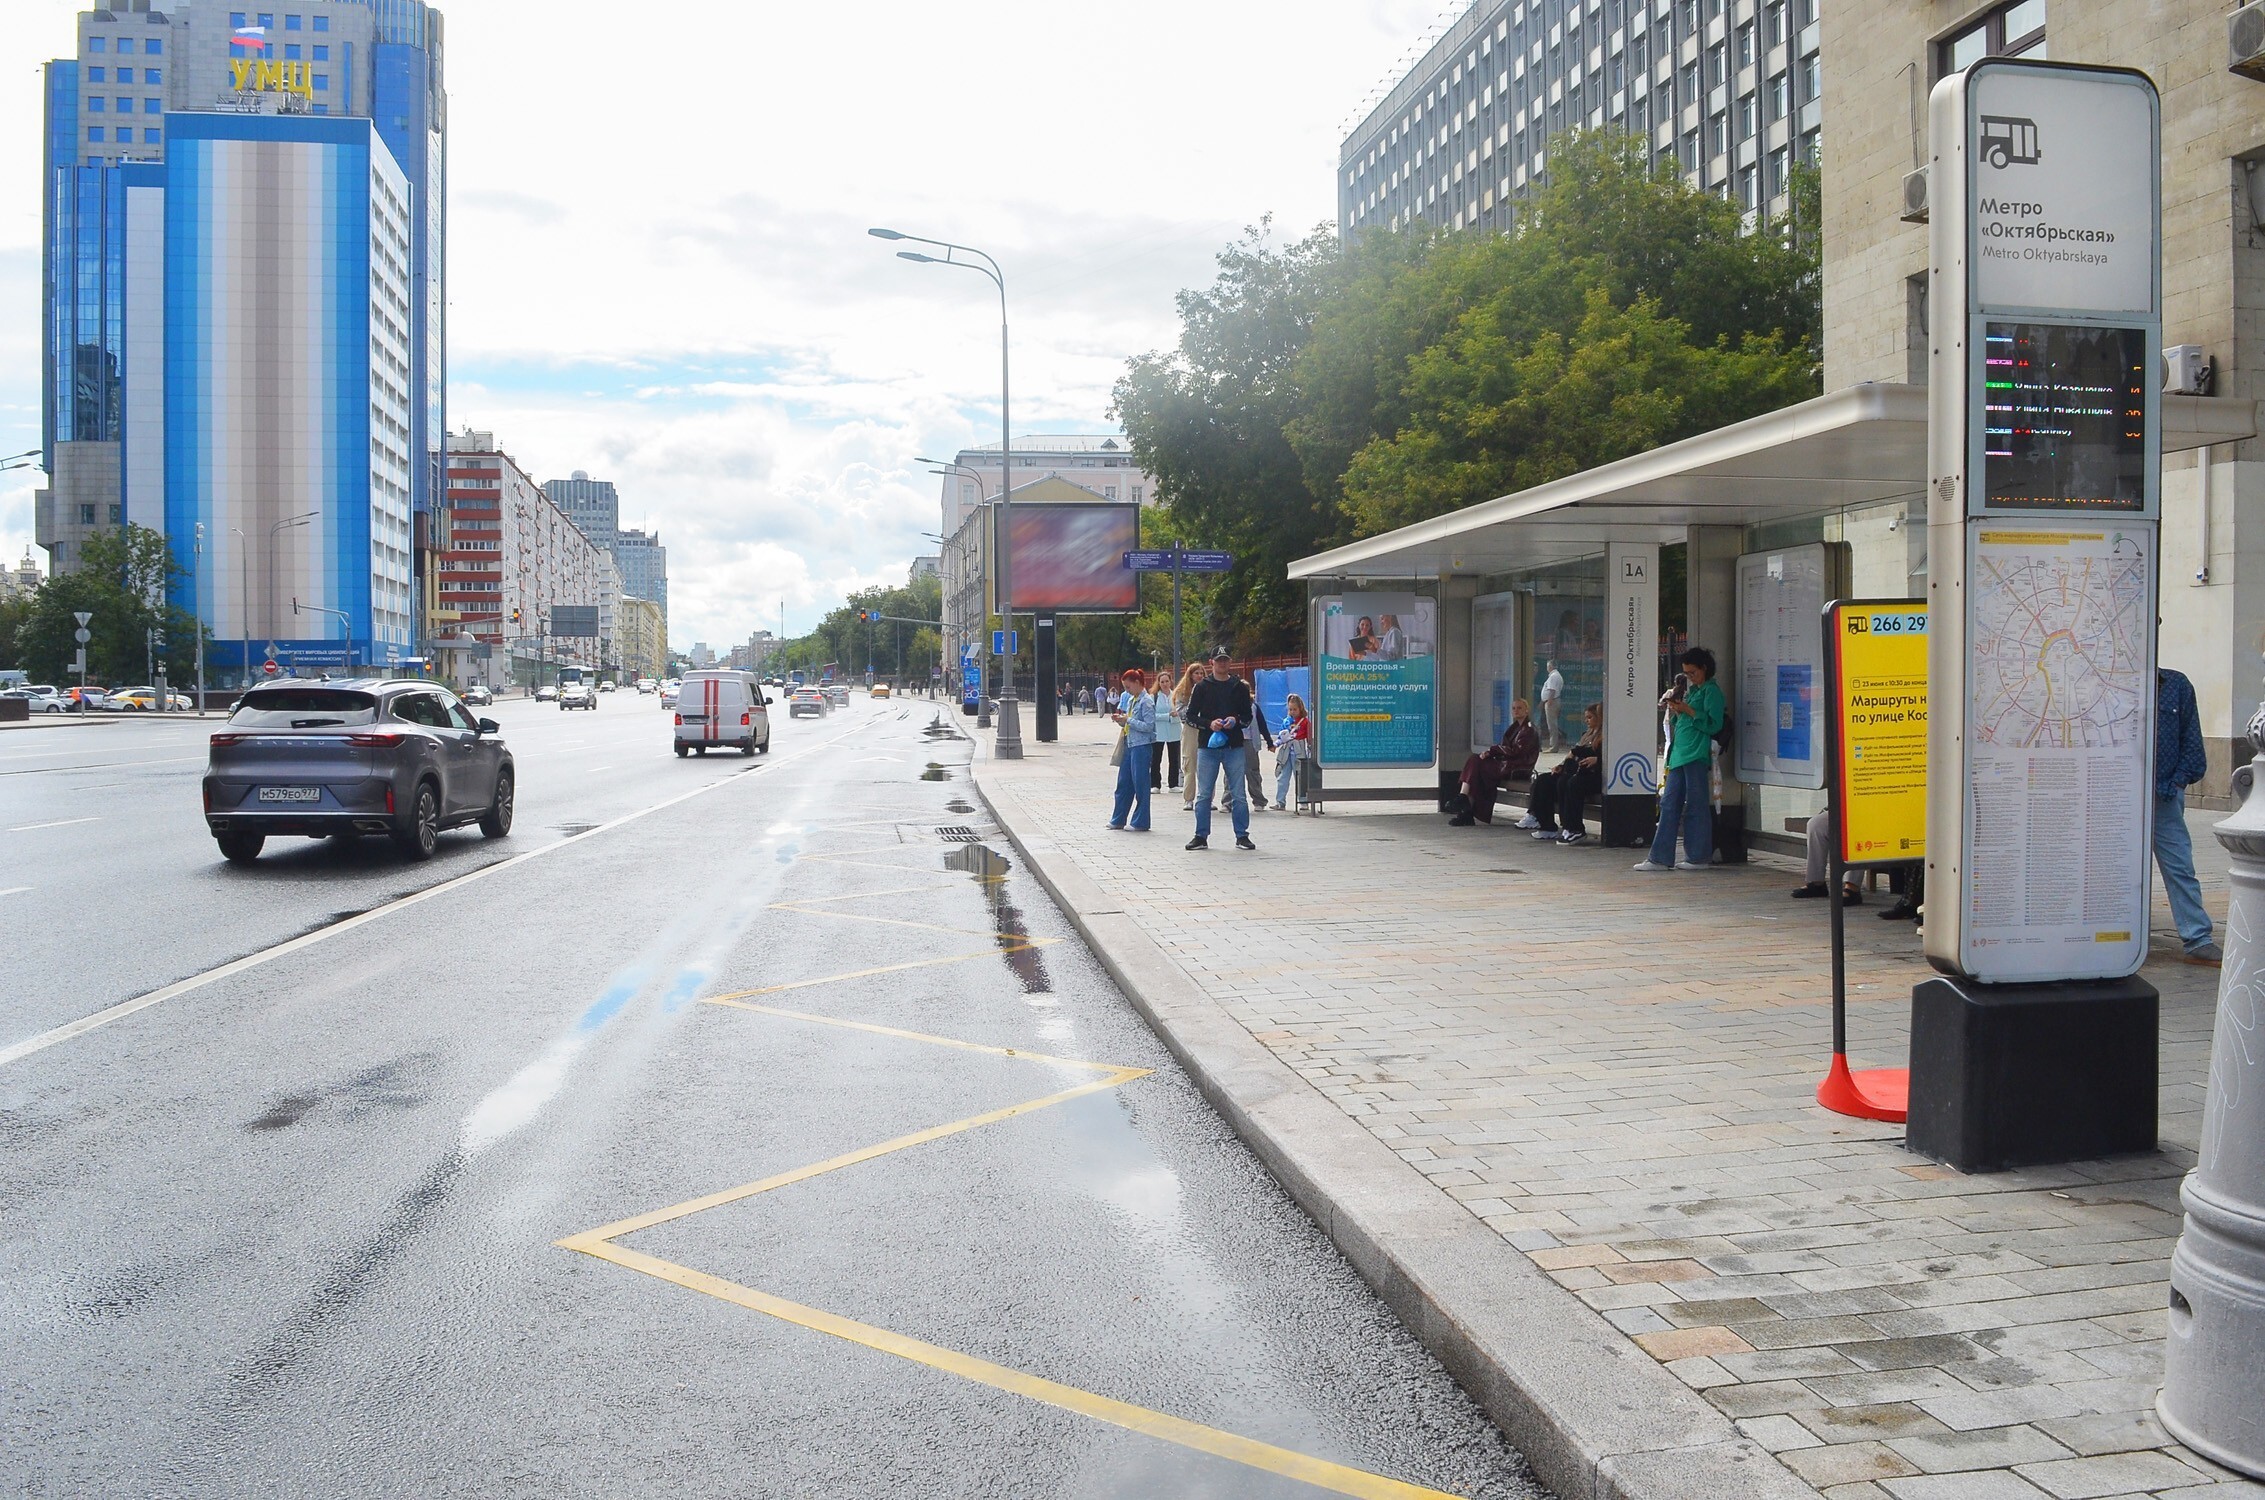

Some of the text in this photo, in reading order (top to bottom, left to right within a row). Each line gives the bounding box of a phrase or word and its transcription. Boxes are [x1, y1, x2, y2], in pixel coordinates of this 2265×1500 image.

[230, 58, 312, 100] УМЦ
[1980, 198, 2042, 218] Метро
[1982, 222, 2114, 244] «Октябрьская»
[1982, 246, 2108, 266] Metro Oktyabrskaya
[1874, 616, 1928, 632] 266 29
[1626, 596, 1636, 698] Метро «Октябрьская»
[1326, 662, 1354, 672] Время
[1356, 663, 1398, 672] здоровья
[1326, 673, 1365, 682] СКИДКА
[1851, 695, 1916, 708] Маршруты
[1852, 710, 1927, 725] по улице Кос
